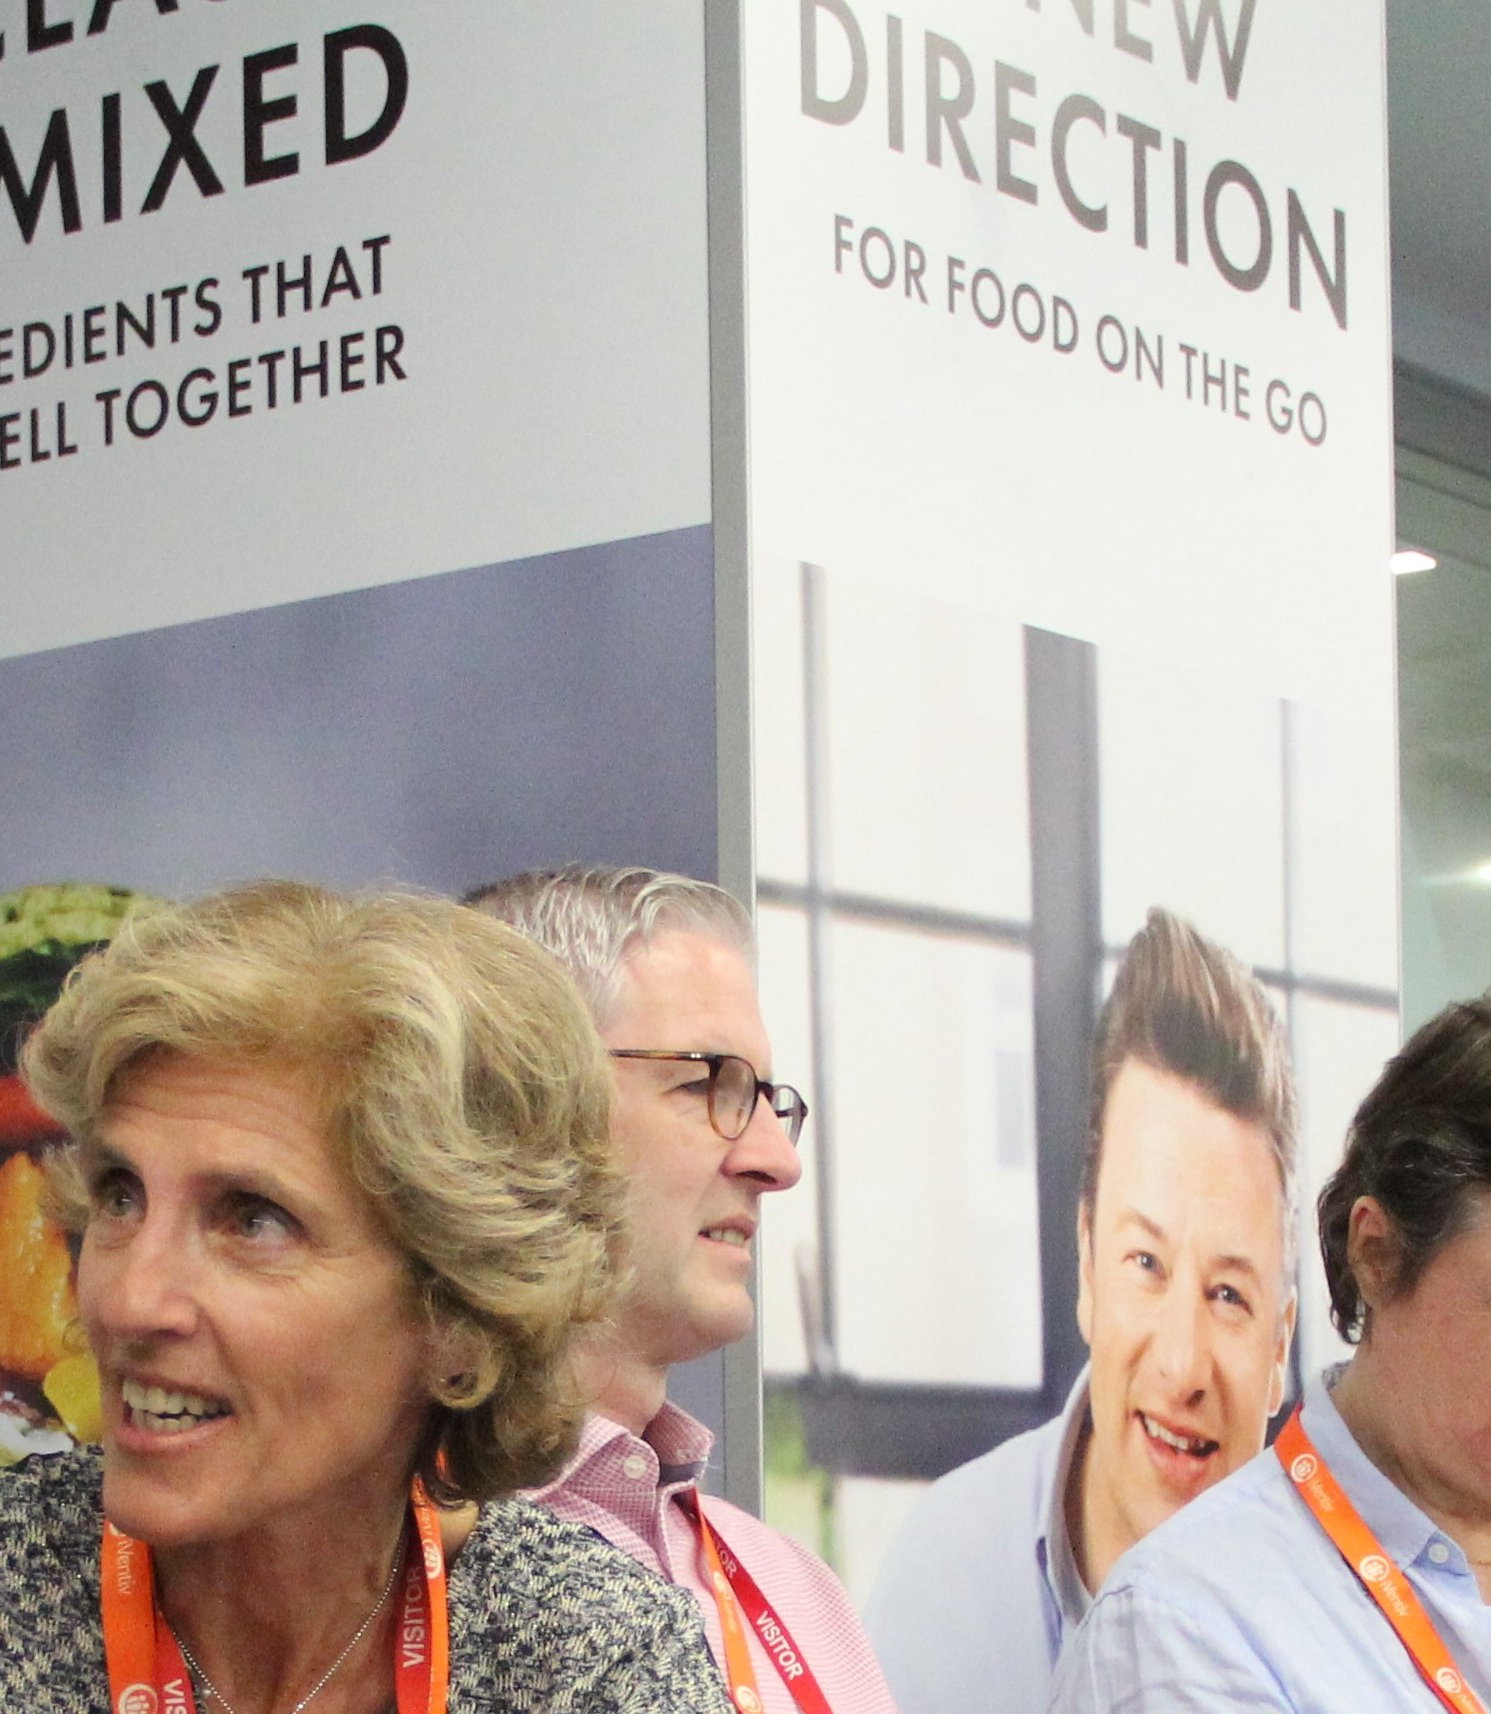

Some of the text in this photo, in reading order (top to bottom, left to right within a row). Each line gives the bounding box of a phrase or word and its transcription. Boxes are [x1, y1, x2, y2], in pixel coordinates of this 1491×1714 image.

[800, 0, 1349, 331] DIRECTION
[242, 235, 392, 326] THAT
[834, 213, 1328, 448] FOR FOOD ON THE GO
[94, 324, 408, 447] TOGETHER
[755, 1610, 805, 1681] VISITOR
